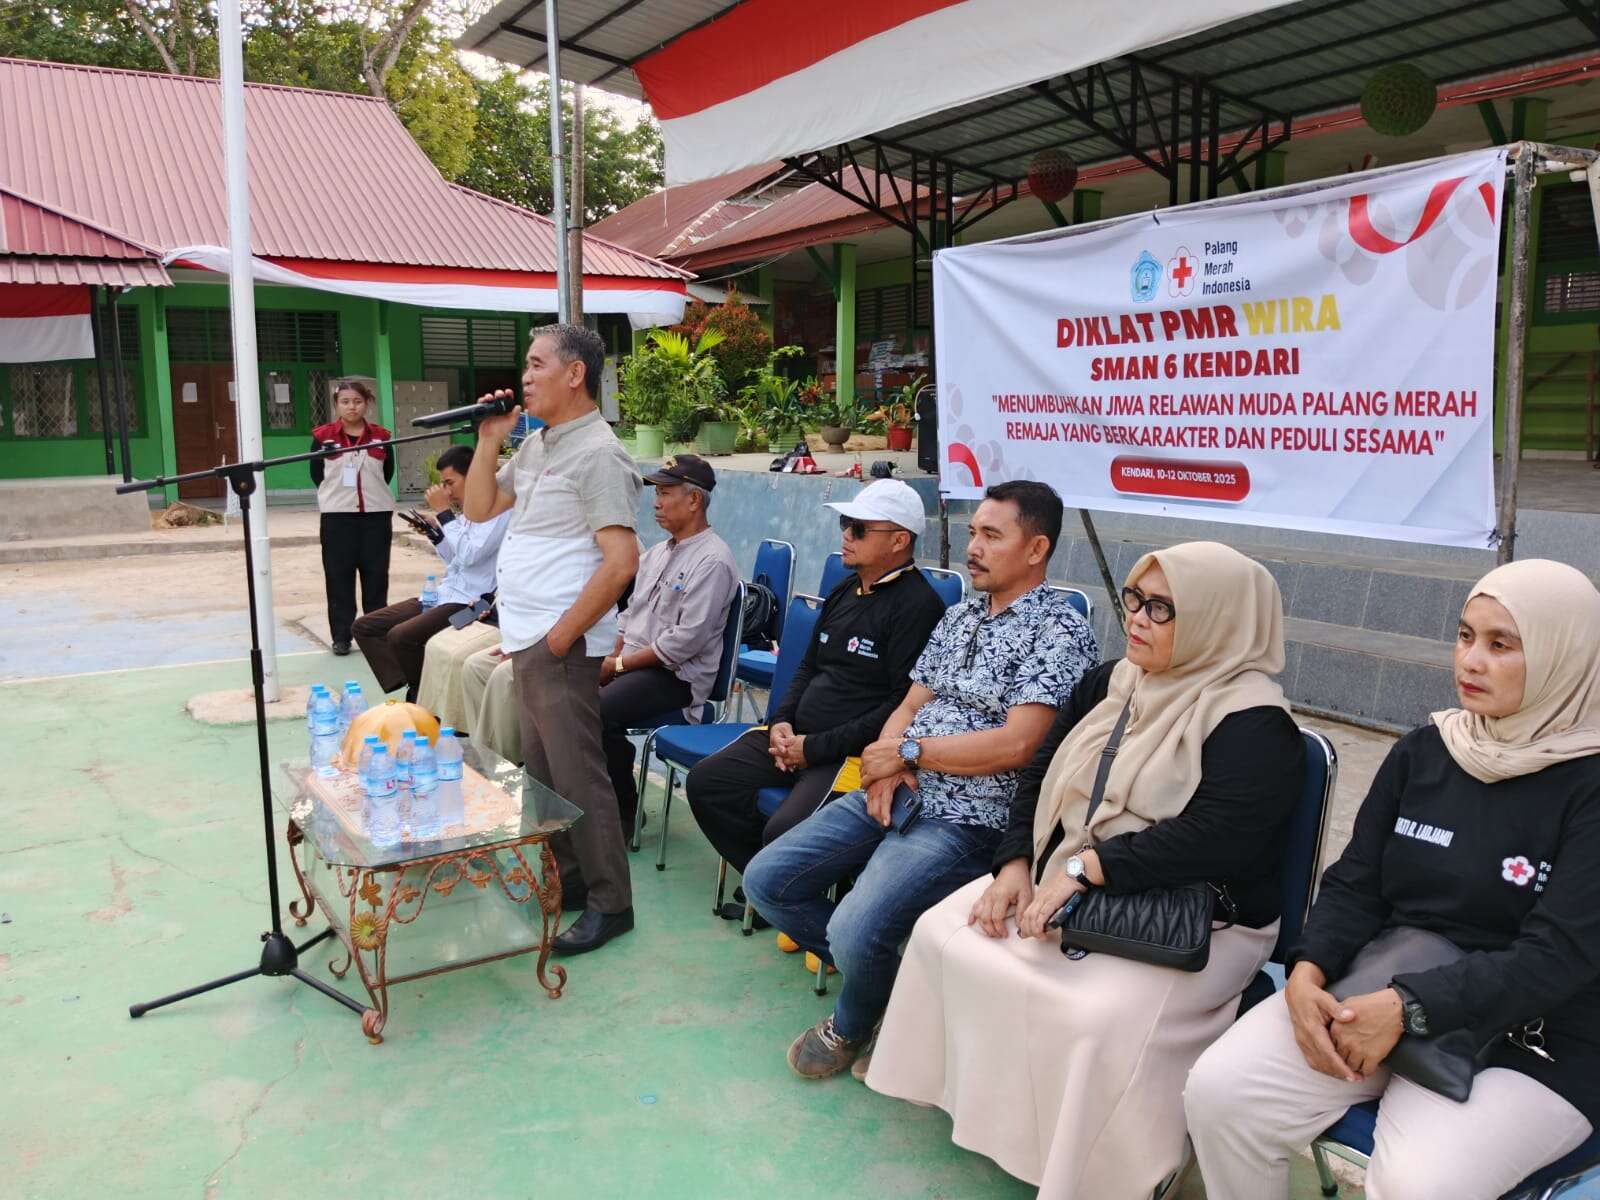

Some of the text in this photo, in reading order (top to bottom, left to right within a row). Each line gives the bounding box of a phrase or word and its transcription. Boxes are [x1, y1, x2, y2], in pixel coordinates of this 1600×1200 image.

[1204, 241, 1238, 256] Palang
[1203, 260, 1233, 276] Merah
[1202, 277, 1251, 295] Indonesia
[1056, 294, 1341, 348] DIKLAT PMR WIRA
[1090, 347, 1300, 382] SMAN 6 KENDARI
[992, 394, 1102, 416] "MENUMBUHKAN
[1149, 393, 1233, 416] RELAWAN
[1239, 392, 1297, 416] MUDA
[1302, 390, 1388, 417] PALANG
[1394, 390, 1477, 417] MERAH
[1006, 421, 1445, 456] REMAJA YANG BERKARAKTER DAN PEDULI SESAMA"
[1121, 466, 1236, 484] KENDARI, 10-12 OKTOBER 2025
